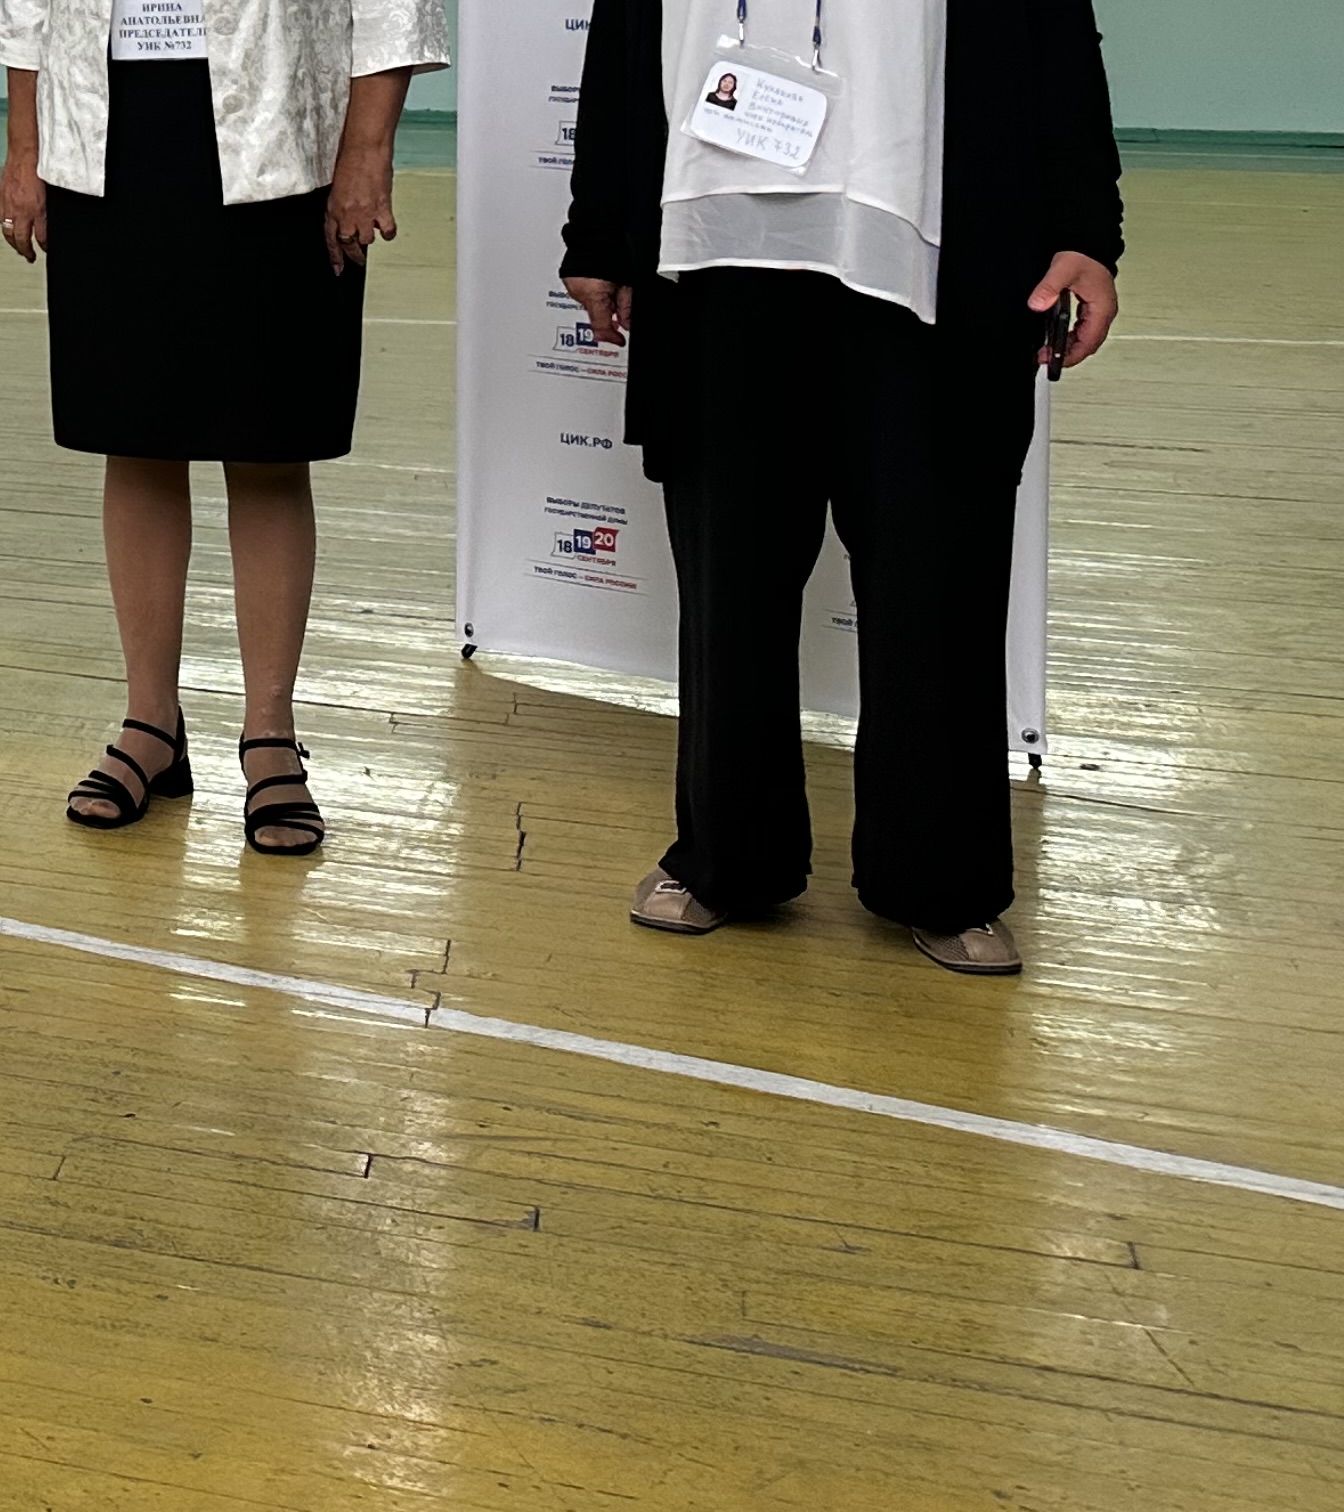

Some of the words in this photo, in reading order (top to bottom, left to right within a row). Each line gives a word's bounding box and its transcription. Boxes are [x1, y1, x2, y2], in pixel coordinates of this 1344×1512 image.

[142, 3, 183, 13] ИРИНА
[137, 41, 162, 51] УИК
[561, 127, 576, 141] 18
[560, 333, 575, 347] 18
[578, 328, 594, 342] 19
[560, 433, 613, 450] ЦИК.РФ
[557, 539, 573, 554] 18
[575, 535, 592, 549] 19
[594, 532, 615, 547] 20
